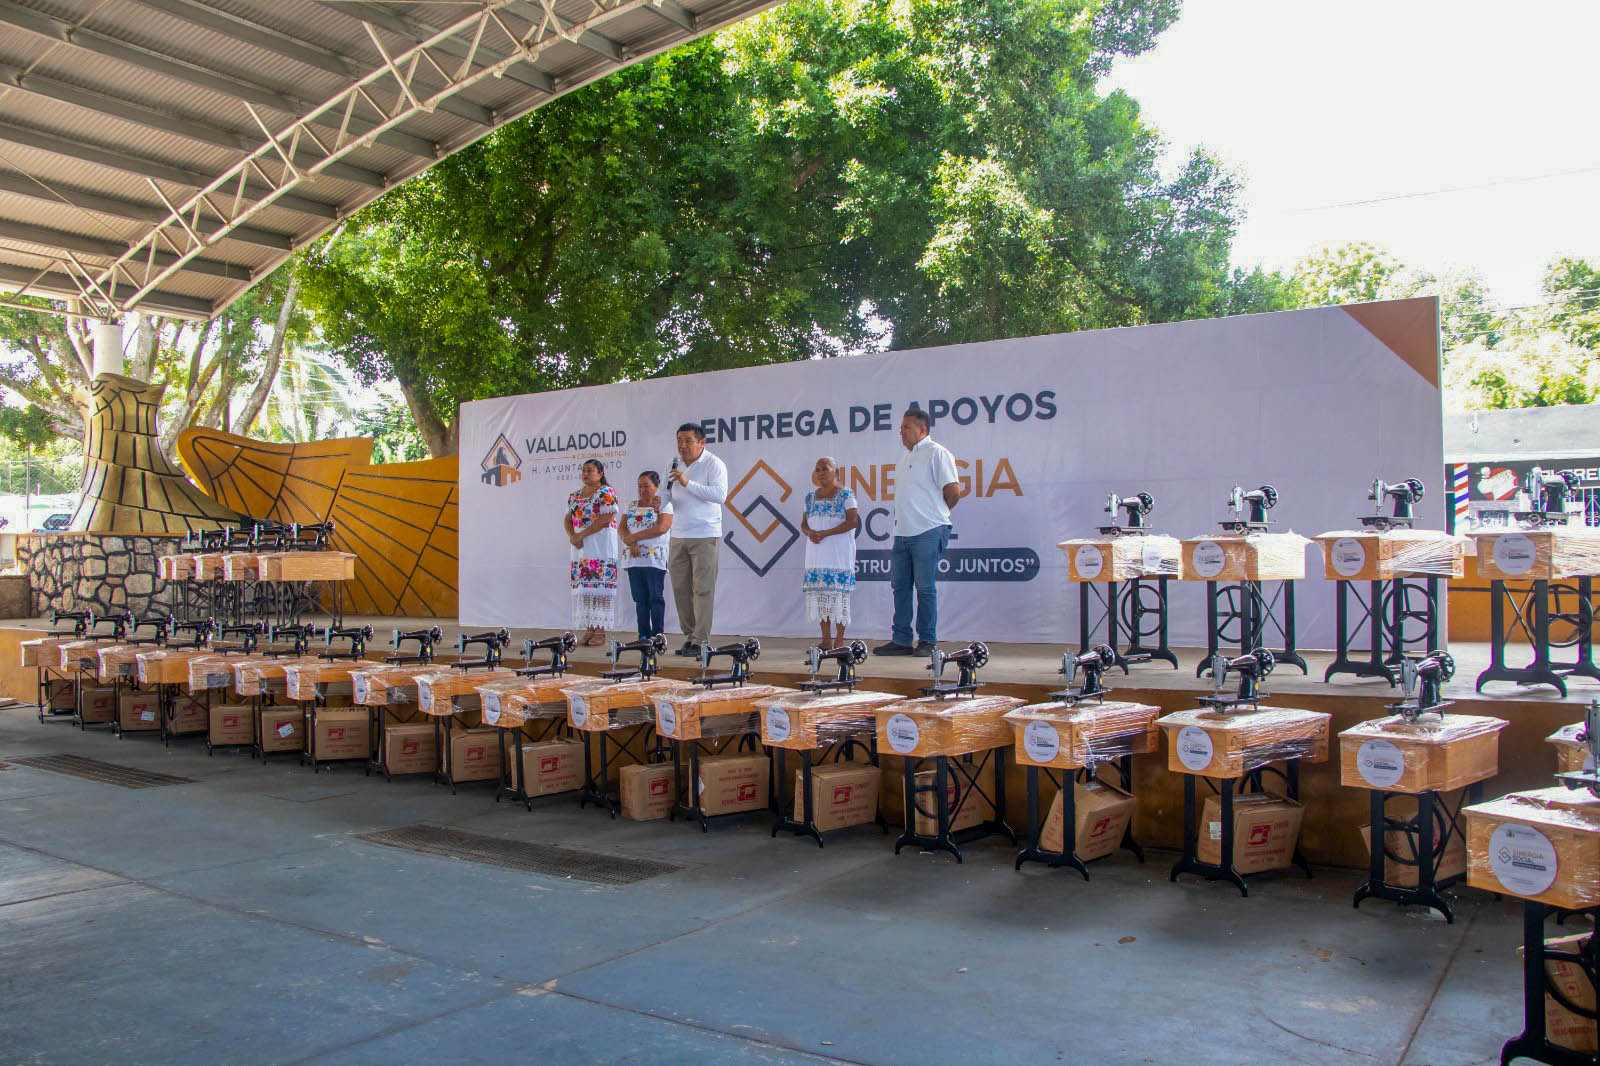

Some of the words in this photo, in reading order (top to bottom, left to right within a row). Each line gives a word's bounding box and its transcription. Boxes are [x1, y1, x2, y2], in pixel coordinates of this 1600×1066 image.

[701, 408, 839, 444] ENTREGA
[849, 403, 892, 433] DE
[525, 430, 627, 454] VALLADOLID
[545, 460, 622, 474] AYUNTANTO
[811, 457, 1024, 502] INEGIA
